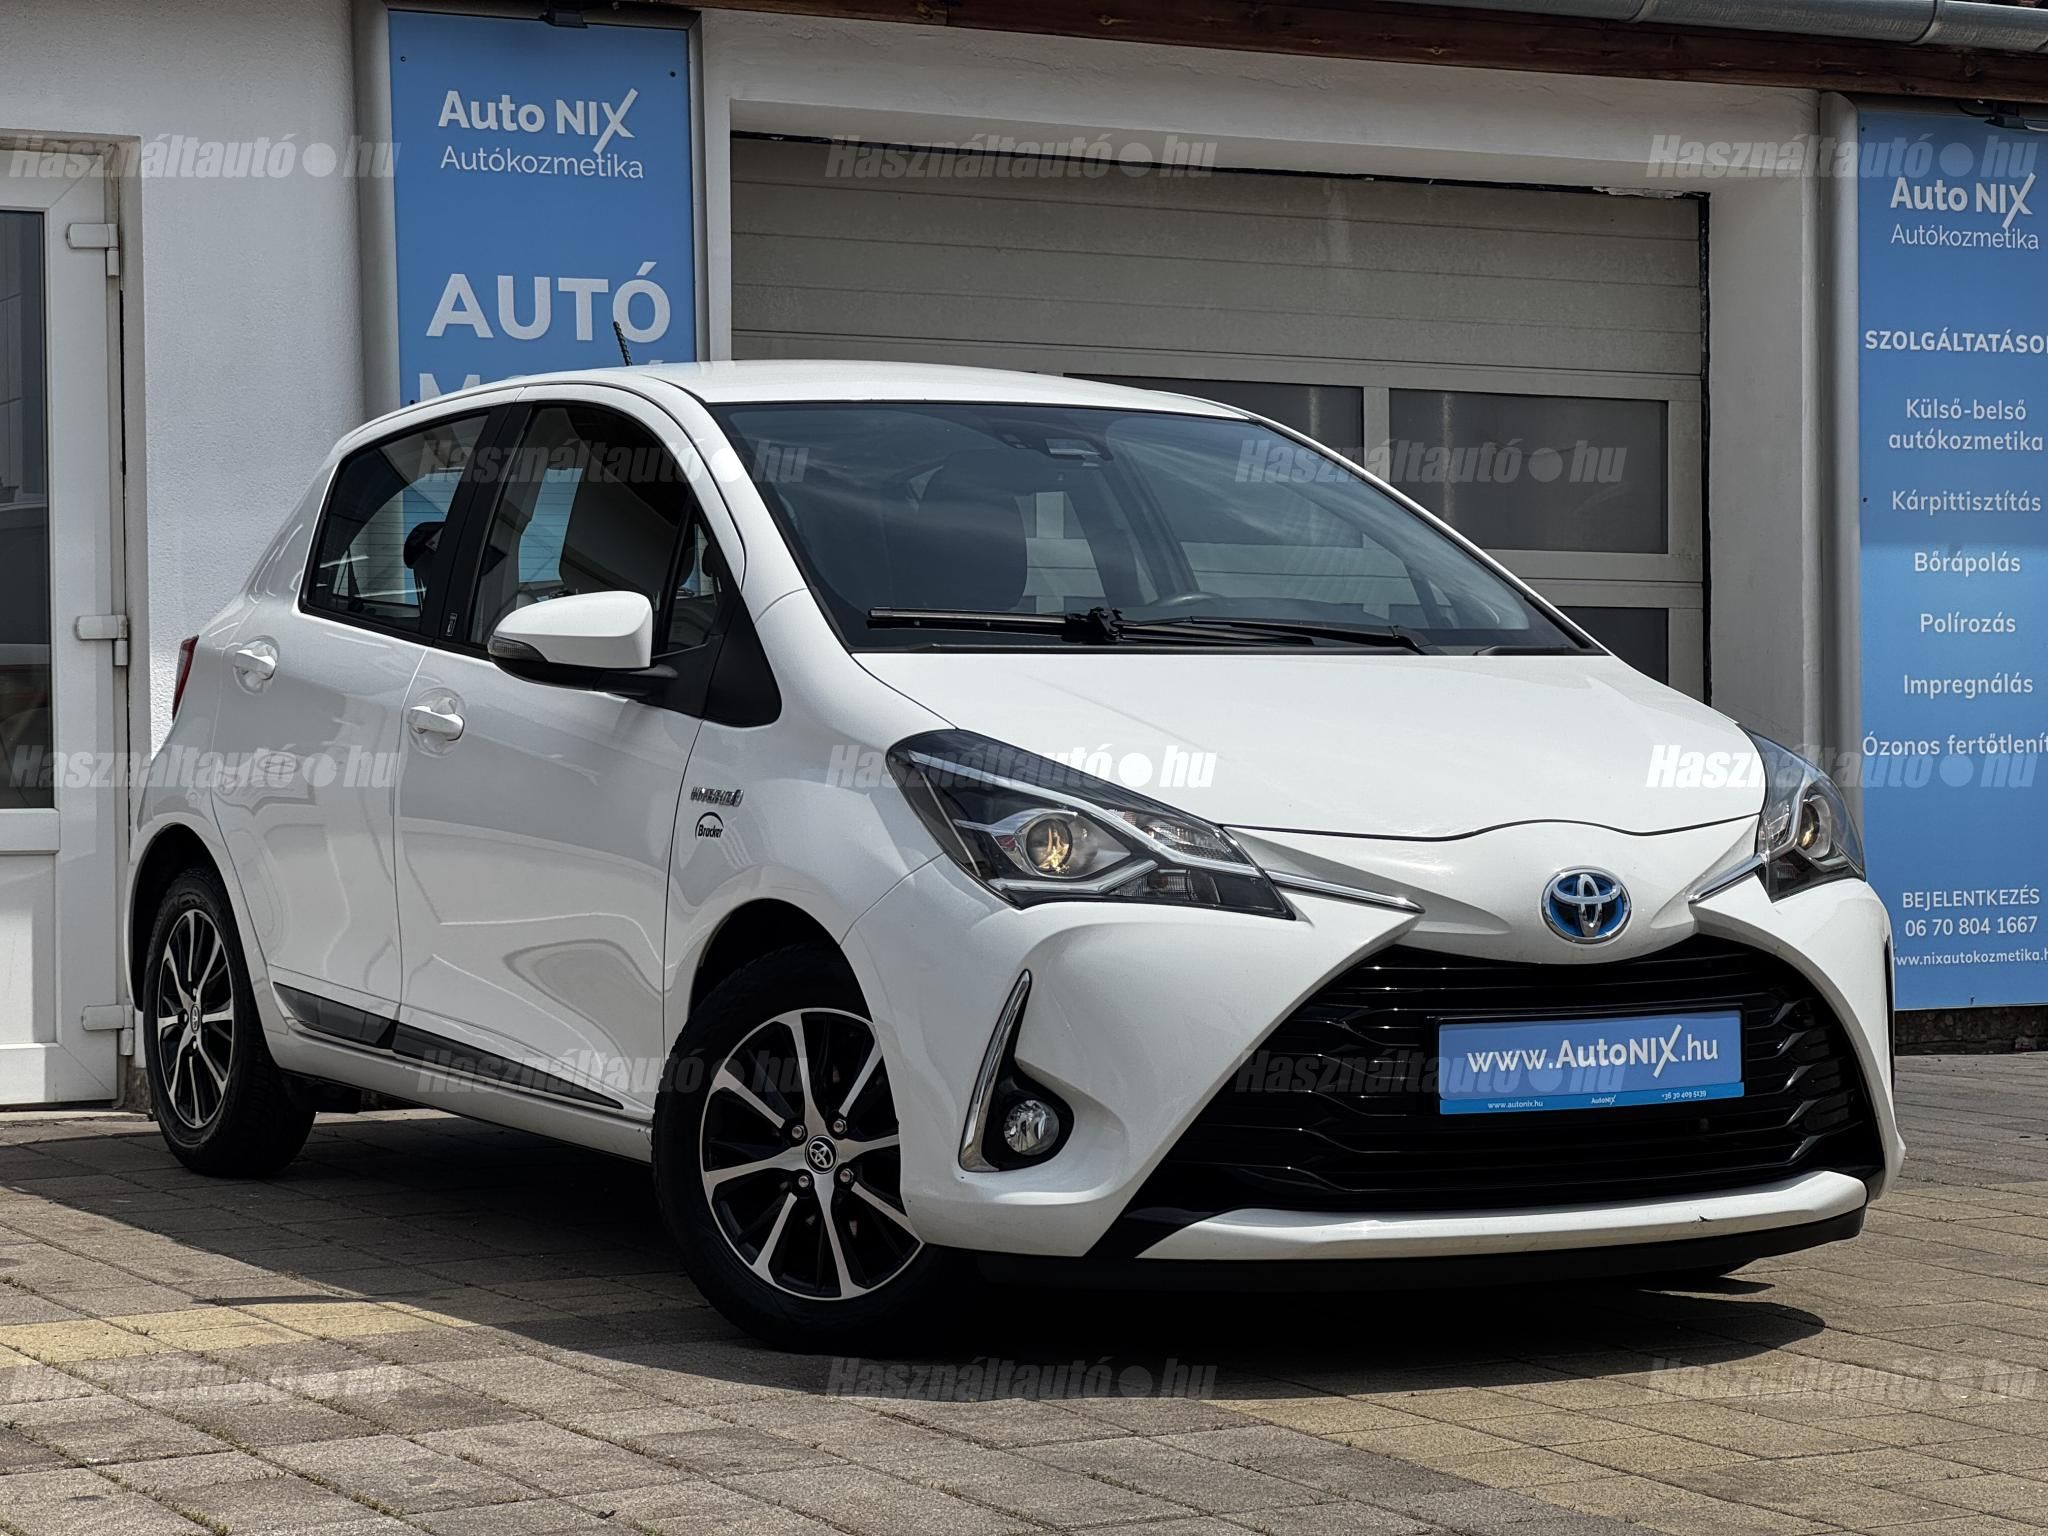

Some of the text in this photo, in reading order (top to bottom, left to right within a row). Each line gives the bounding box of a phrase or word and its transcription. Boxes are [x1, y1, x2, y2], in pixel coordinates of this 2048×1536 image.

[438, 88, 638, 155] Auto NIX
[440, 145, 644, 181] Autókozmetika
[1891, 173, 2035, 229] Auto NIX
[1891, 223, 2039, 250] Autókozmetika
[426, 262, 672, 343] AUTÓ
[1865, 327, 2048, 354] SZOLGÁLTATÁSO
[1906, 398, 2027, 420] Külső-belső
[1888, 428, 2044, 451] autókozmetika
[1892, 489, 2042, 516] Kárpittisztítás
[1914, 550, 2021, 577] Bőrápolás
[1920, 612, 2016, 634] Polírozás
[1904, 672, 2034, 699] Impregnálás
[1862, 731, 1941, 756] Ózonos
[1902, 884, 2041, 912] BEJELENTKEZÉS
[1905, 915, 2038, 937] 06 70 804 1667
